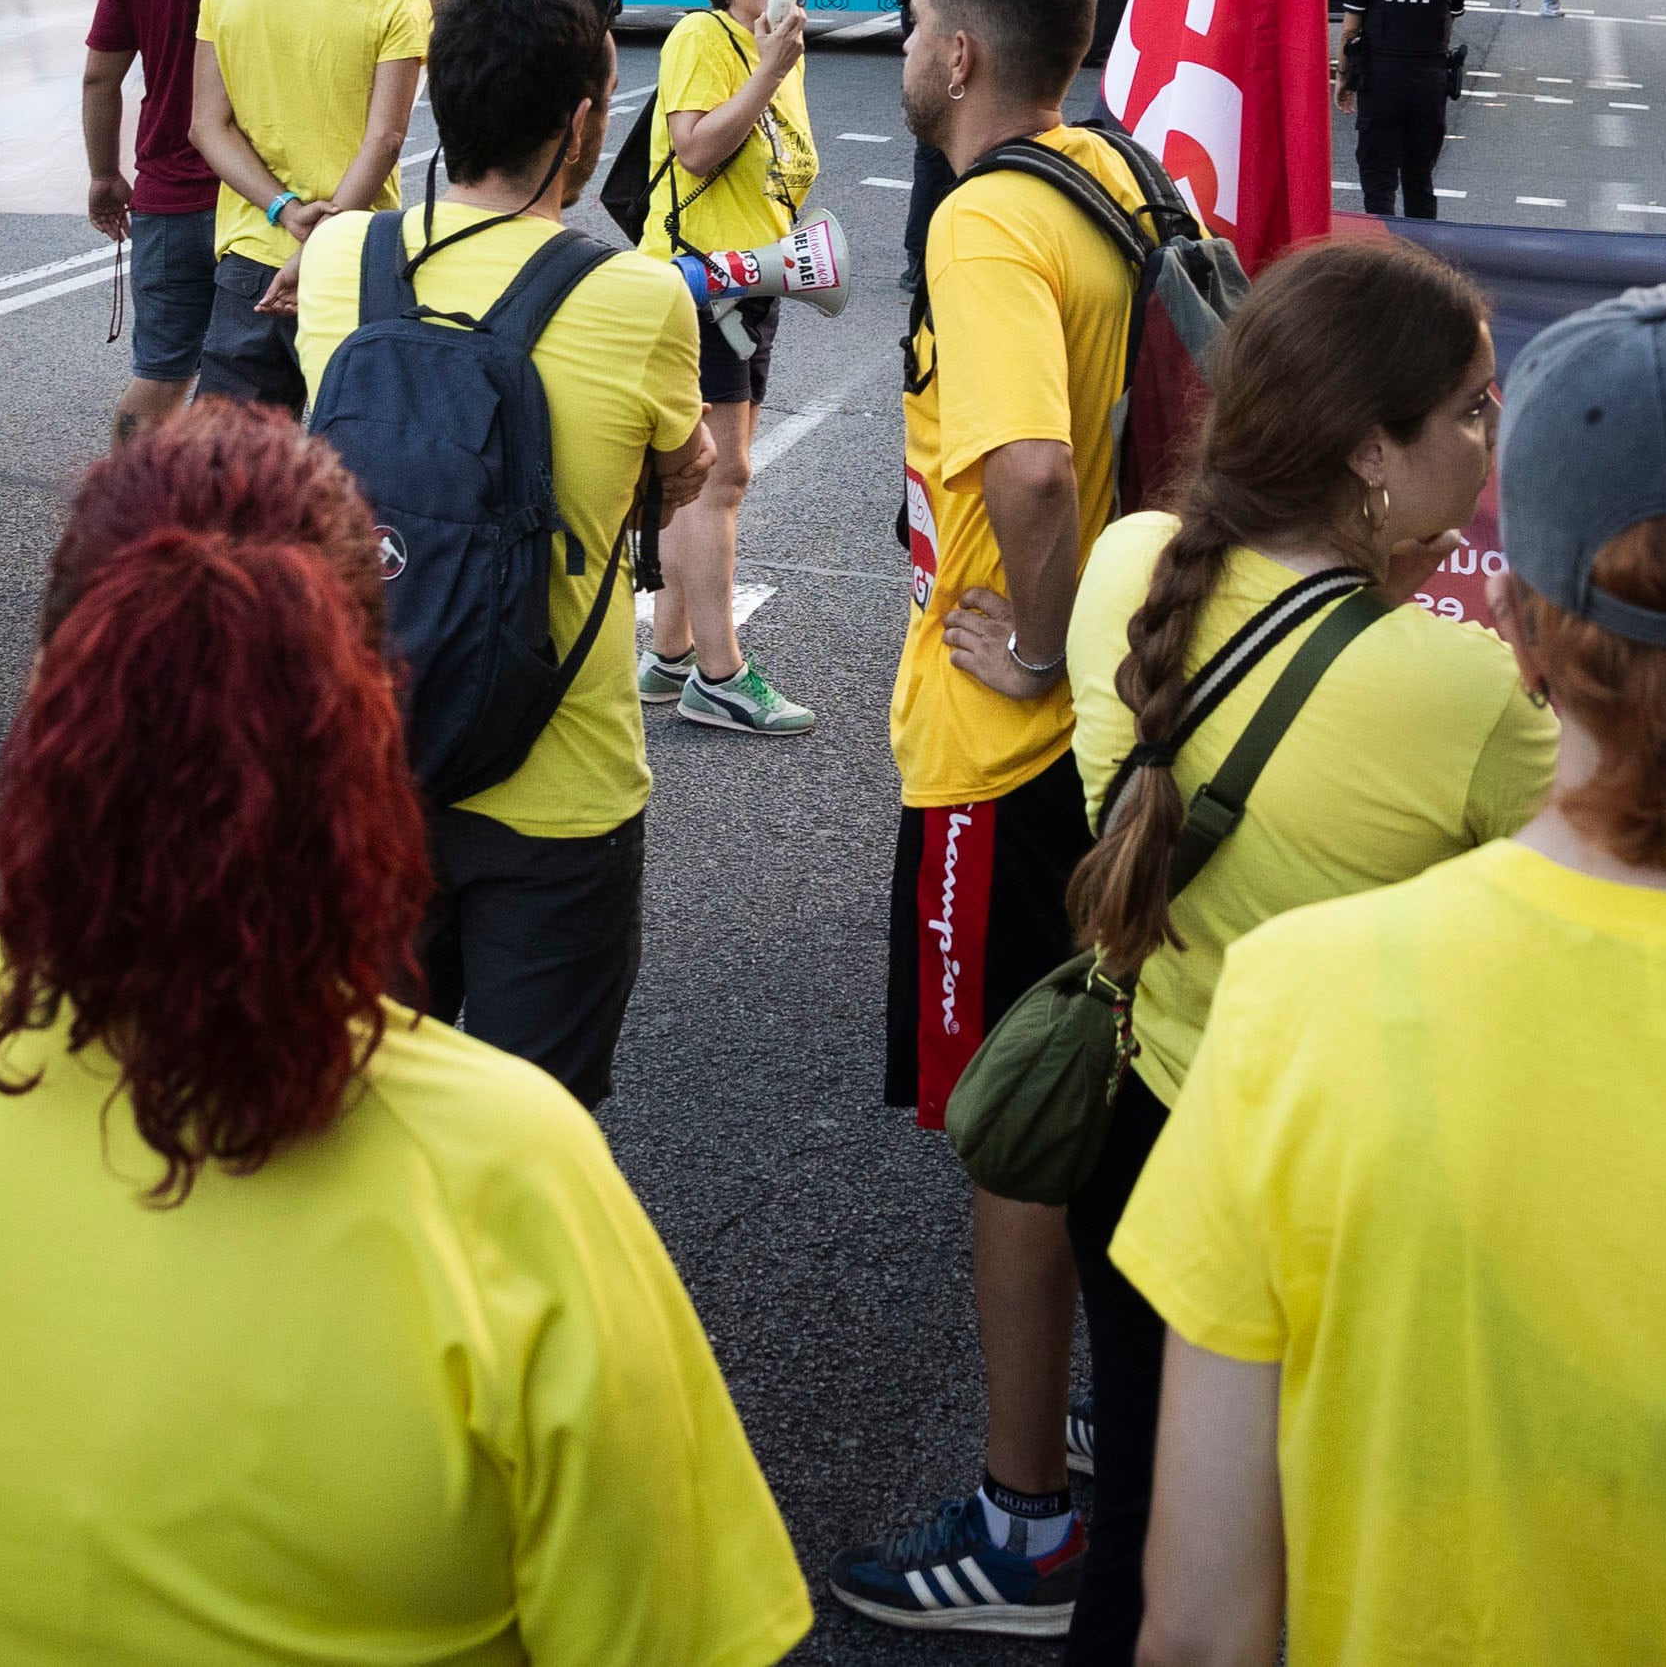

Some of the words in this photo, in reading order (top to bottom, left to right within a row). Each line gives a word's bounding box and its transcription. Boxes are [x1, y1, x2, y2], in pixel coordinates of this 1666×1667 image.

[794, 232, 809, 252] DEL
[928, 802, 973, 1035] hampion
[994, 1488, 1059, 1512] MUNICH
